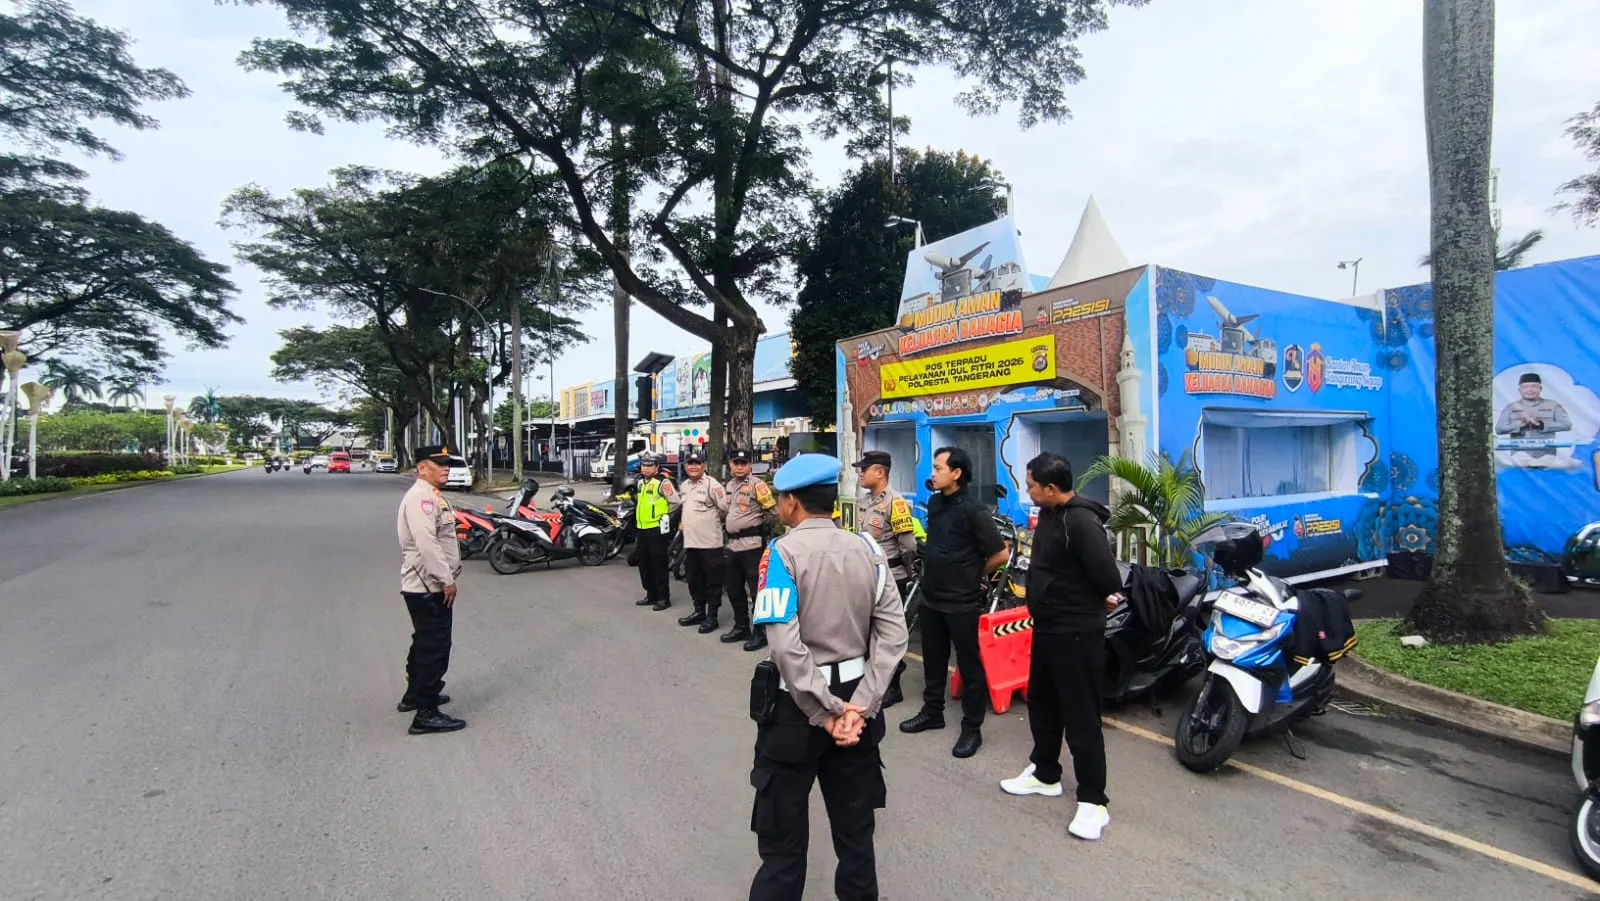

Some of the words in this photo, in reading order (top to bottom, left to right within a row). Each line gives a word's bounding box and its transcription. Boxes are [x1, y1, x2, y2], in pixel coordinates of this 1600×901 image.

[914, 300, 956, 331] MUDIK
[957, 289, 1001, 317] AMAN
[1053, 298, 1110, 321] PRESISI
[899, 322, 958, 356] KELUARGA
[959, 310, 1022, 341] BAHAGIA
[899, 370, 945, 383] PELAYANAN
[947, 367, 968, 376] IDUL
[971, 362, 995, 373] FITRI
[998, 357, 1024, 369] 2026
[925, 362, 942, 371] POS
[945, 355, 987, 368] TERPADU
[908, 377, 949, 389] POLRESTA
[952, 368, 1011, 384] TANGERANG
